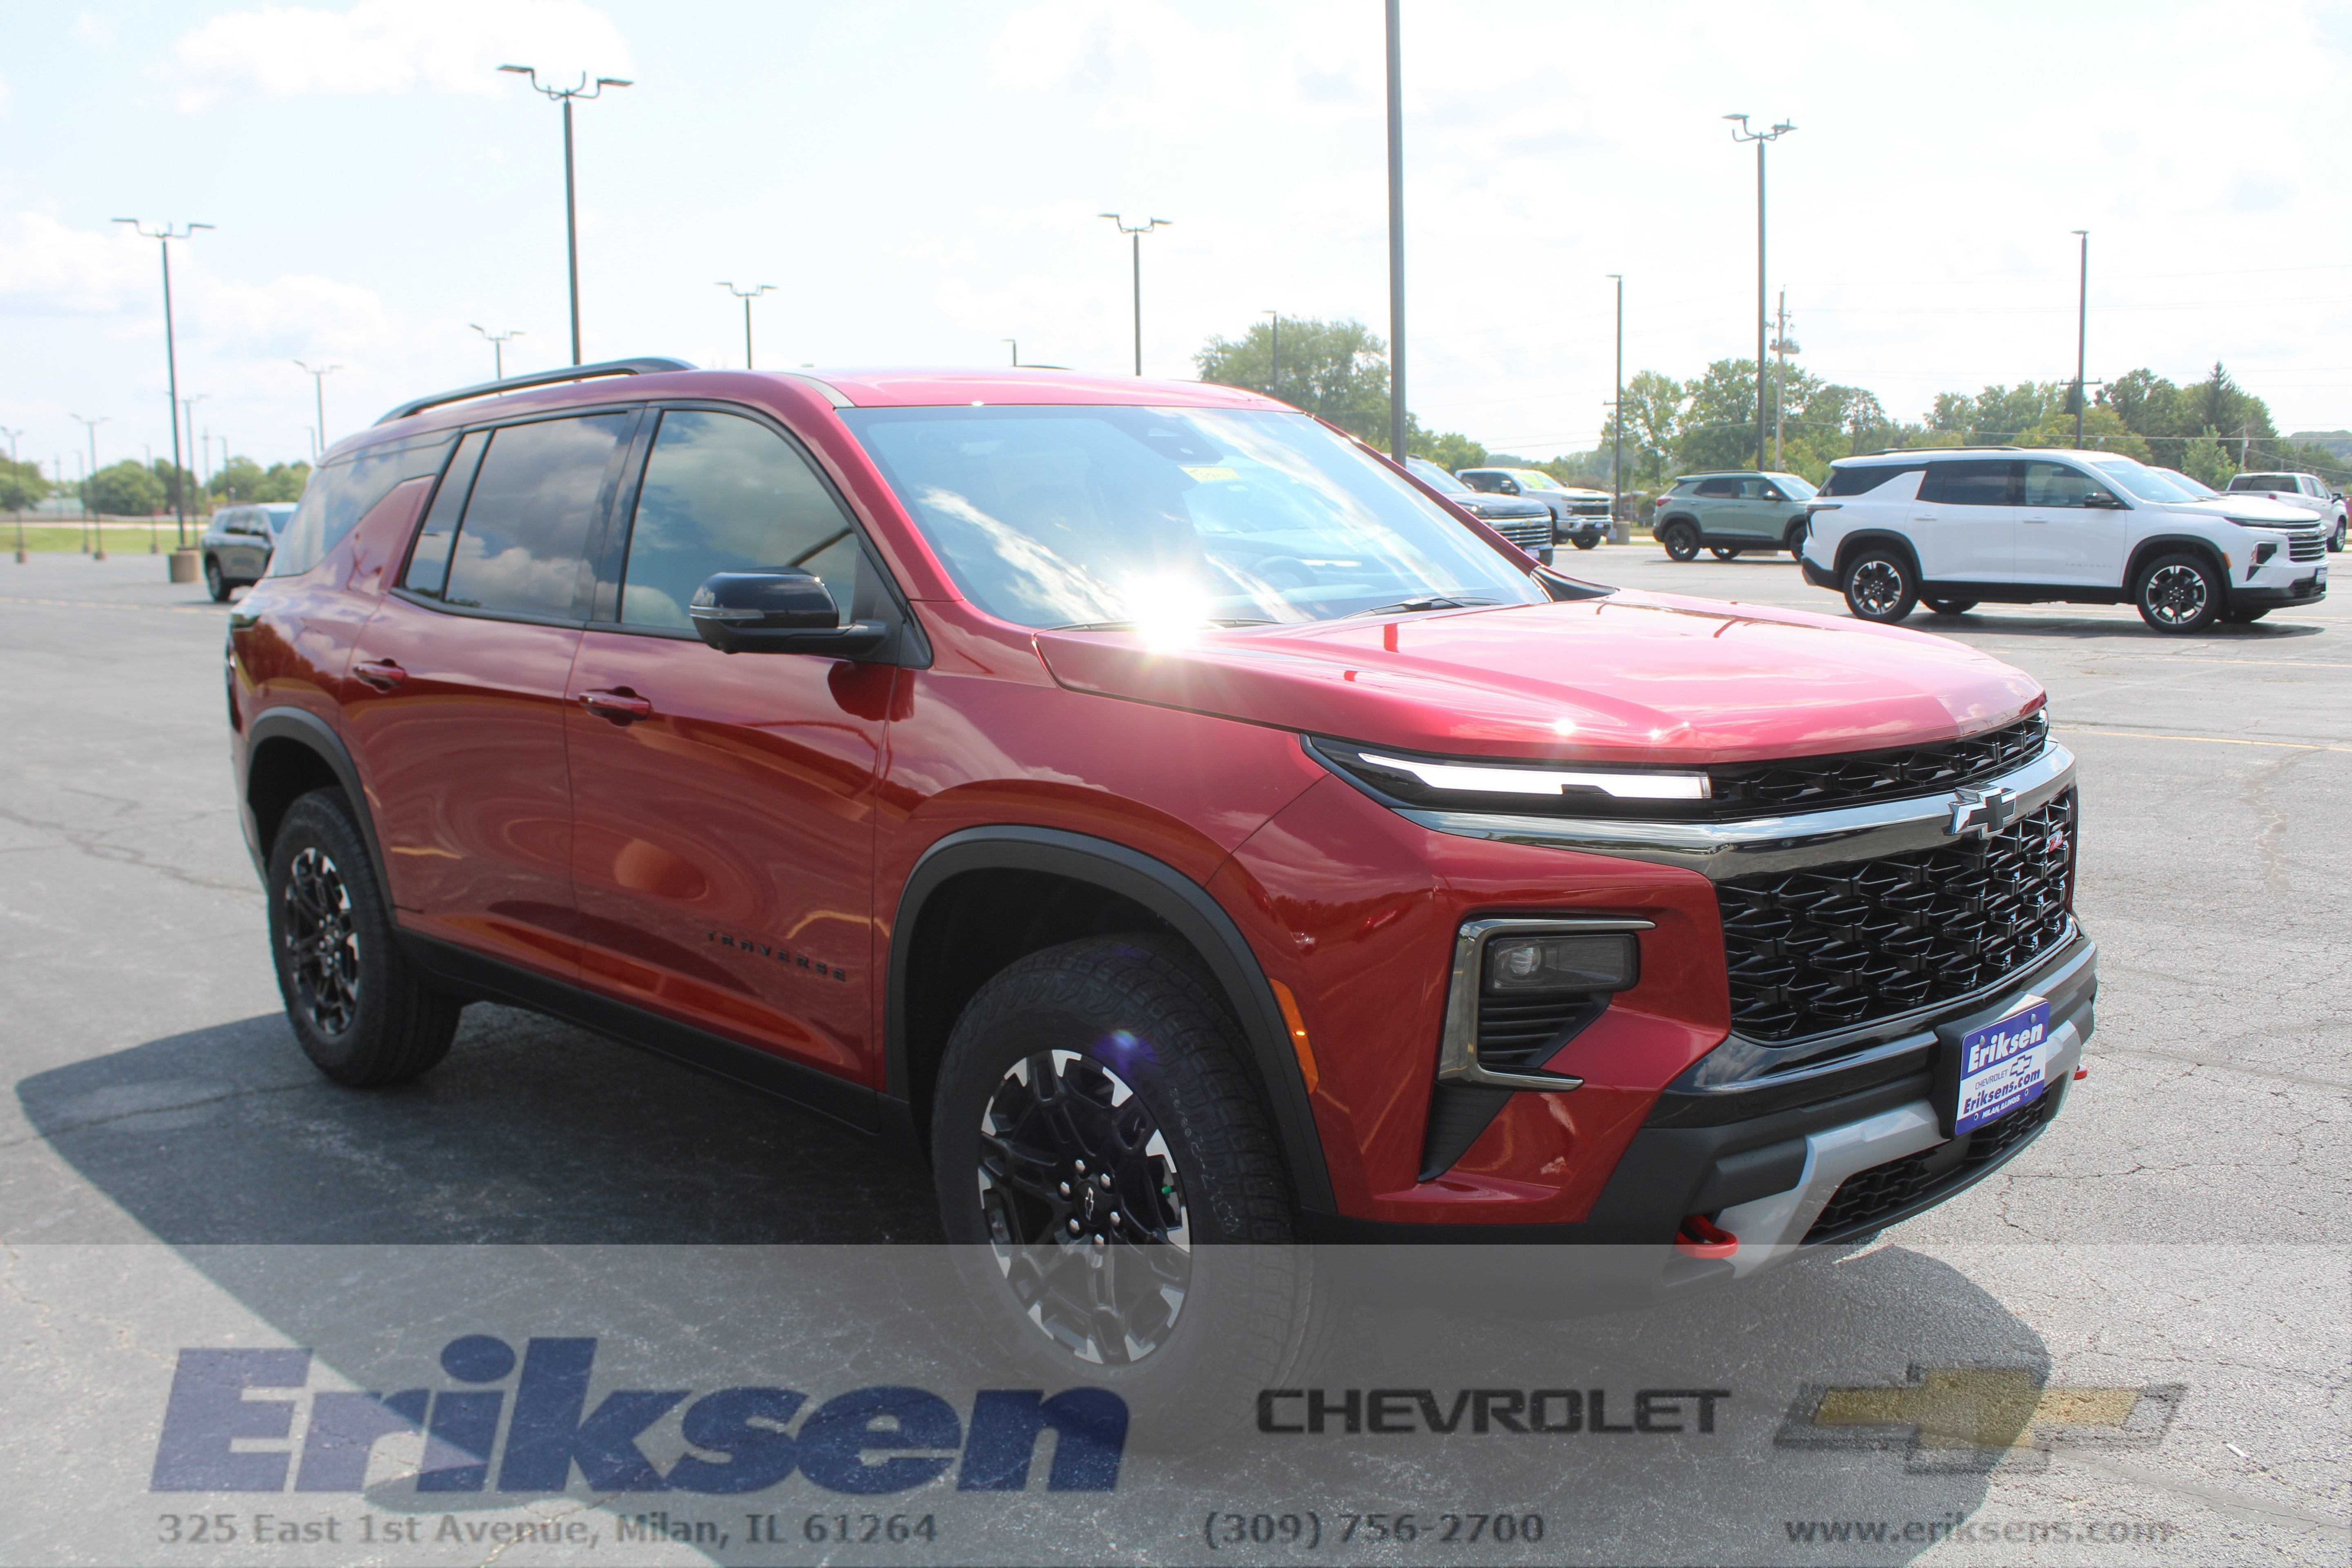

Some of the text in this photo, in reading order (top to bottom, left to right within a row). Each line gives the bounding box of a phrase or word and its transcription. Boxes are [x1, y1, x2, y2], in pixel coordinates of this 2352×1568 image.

[704, 929, 846, 982] TRAVERSE
[1967, 1023, 2043, 1073] Eriksen
[1963, 1068, 2040, 1114] Eriksens.com
[1975, 1068, 2009, 1090] CHEVROLET
